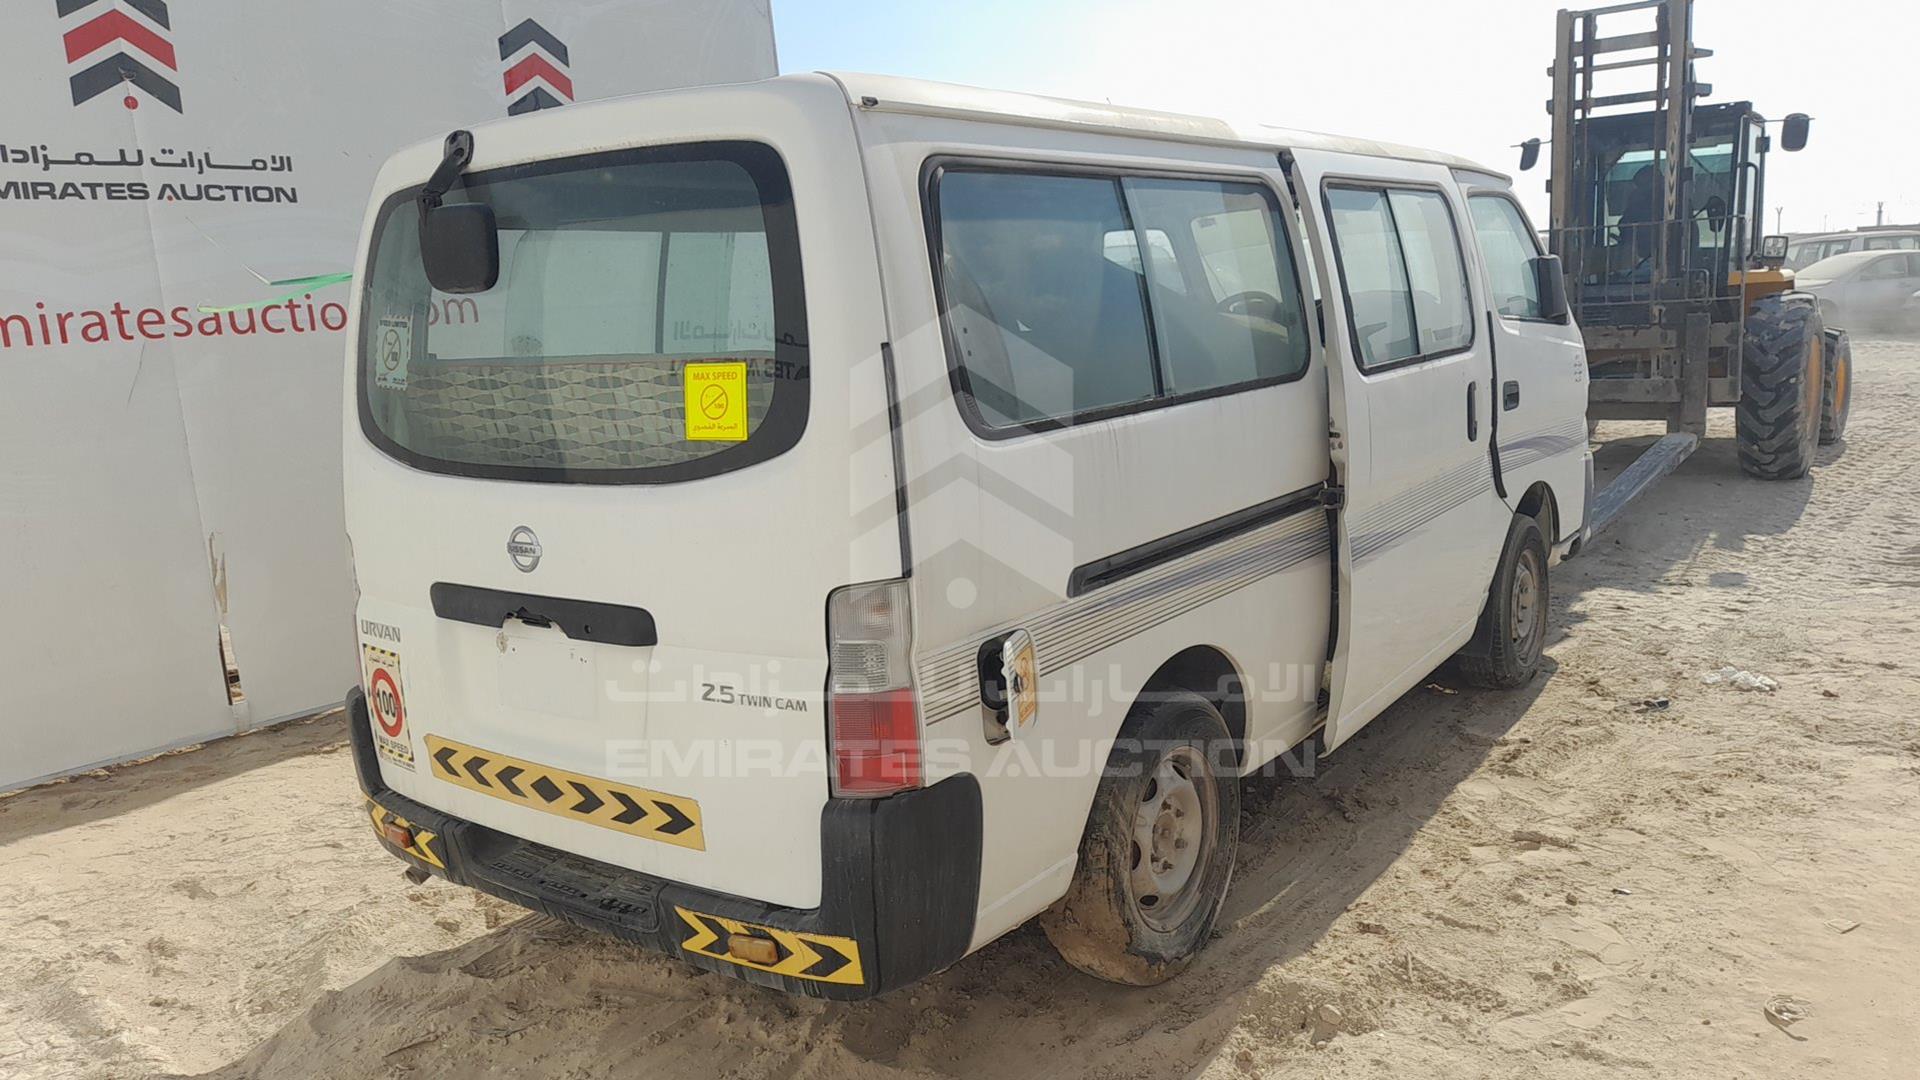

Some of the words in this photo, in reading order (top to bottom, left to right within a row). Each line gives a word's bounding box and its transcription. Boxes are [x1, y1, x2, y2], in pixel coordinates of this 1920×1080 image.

[157, 183, 298, 203] AUCTION
[692, 372, 710, 380] MAX
[711, 371, 738, 380] SPEED
[360, 618, 401, 643] URVAN
[376, 688, 397, 718] 100
[701, 683, 736, 704] 2.5
[737, 693, 773, 709] TWIN
[775, 697, 808, 713] CAM
